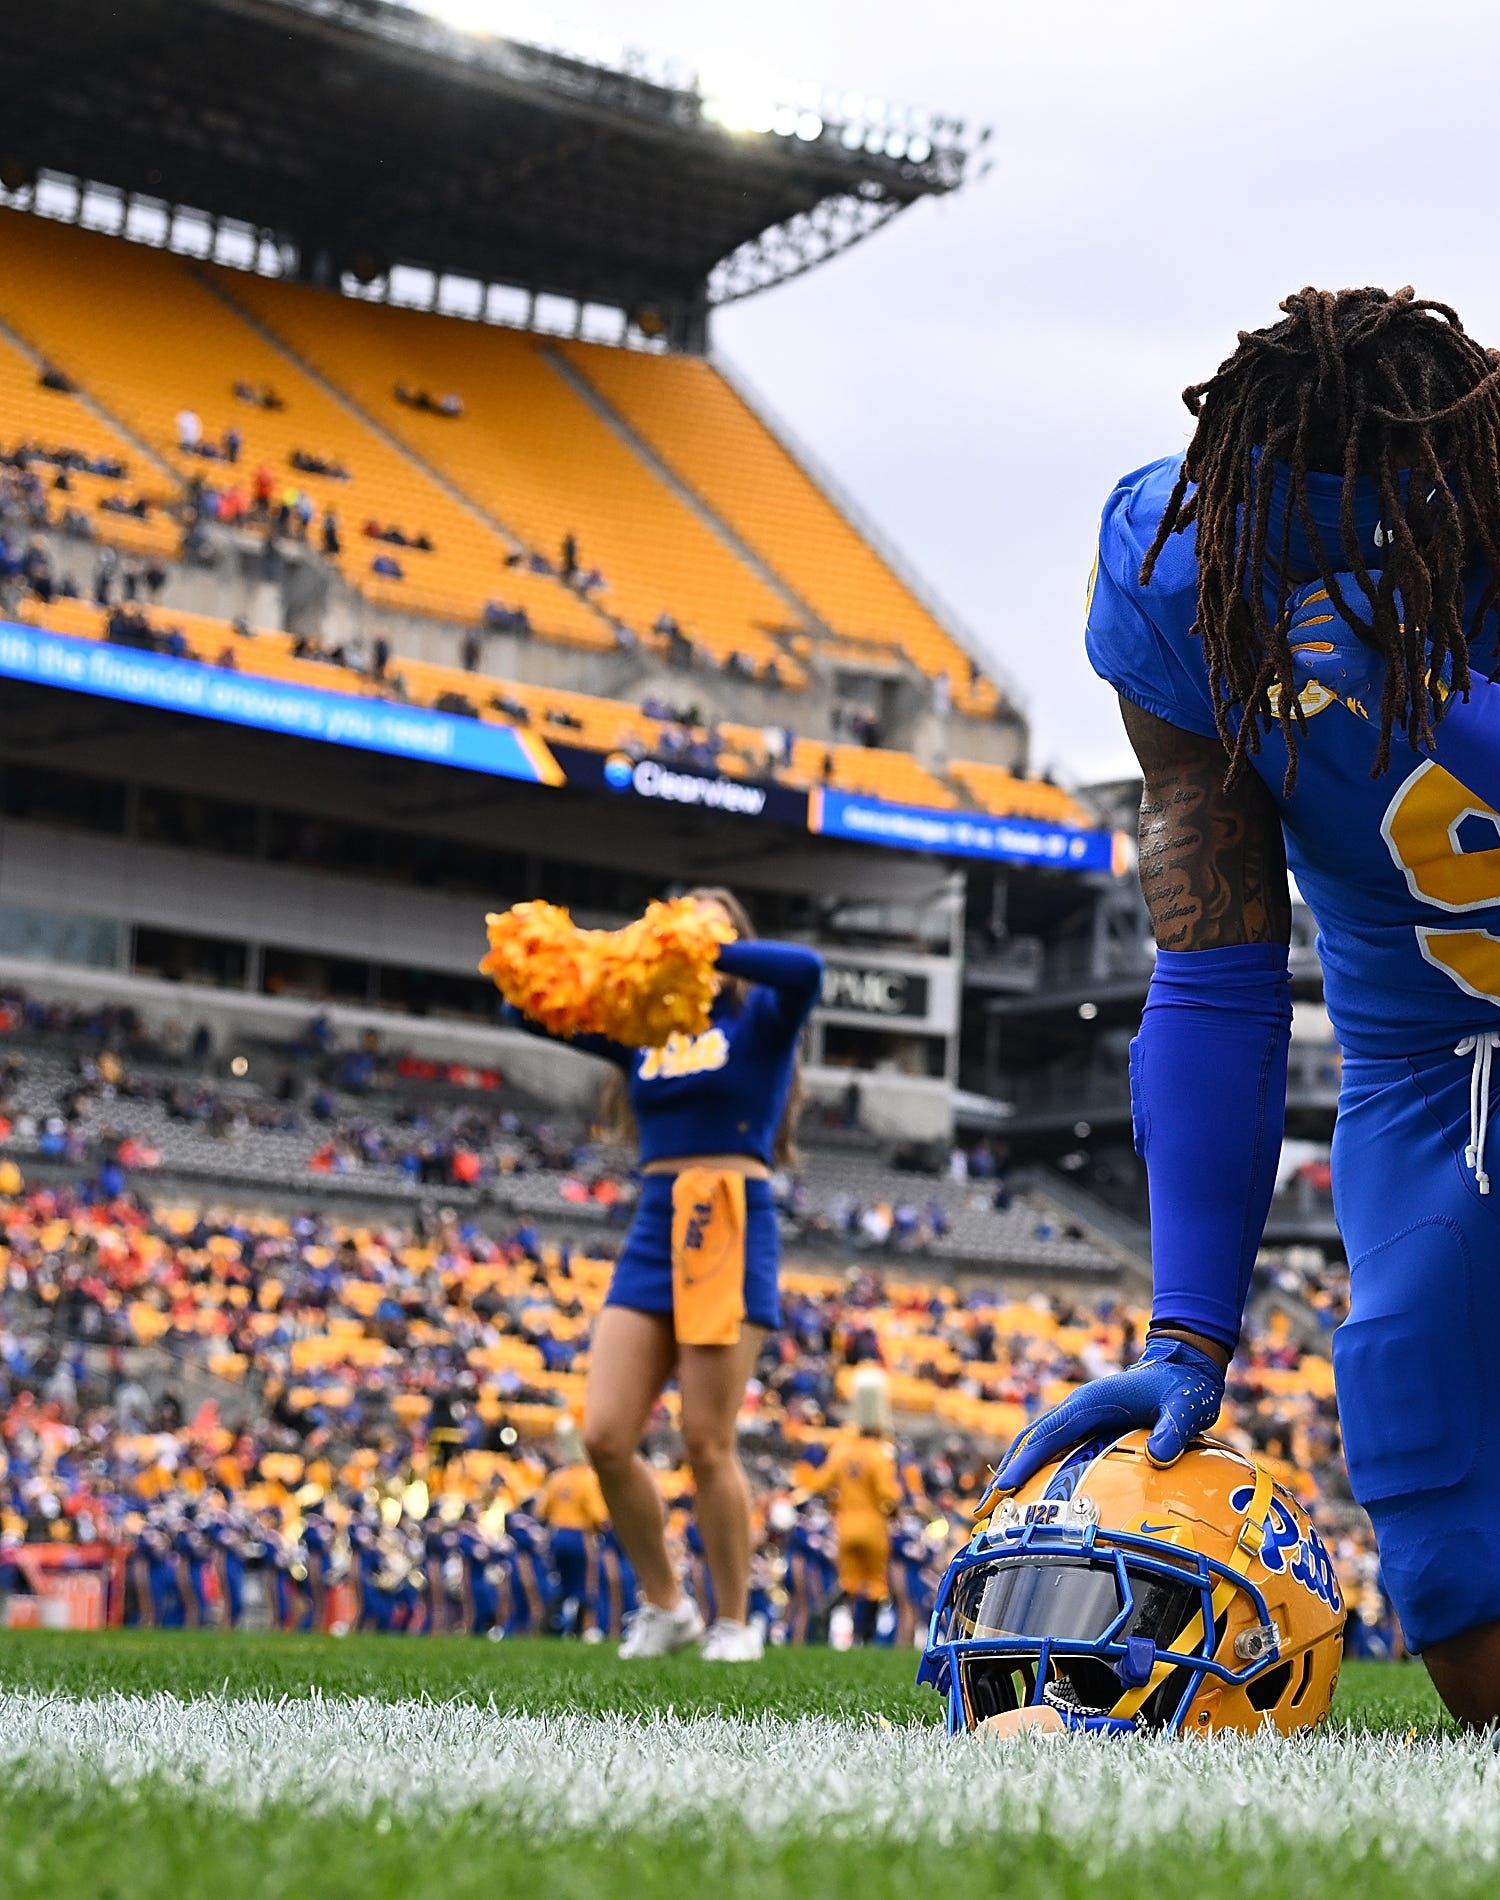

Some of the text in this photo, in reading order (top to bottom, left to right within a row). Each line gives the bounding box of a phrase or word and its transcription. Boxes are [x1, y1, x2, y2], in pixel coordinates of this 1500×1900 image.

[632, 760, 766, 815] Clearview
[1024, 1504, 1061, 1526] H2P
[1229, 1484, 1340, 1614] Pitt
